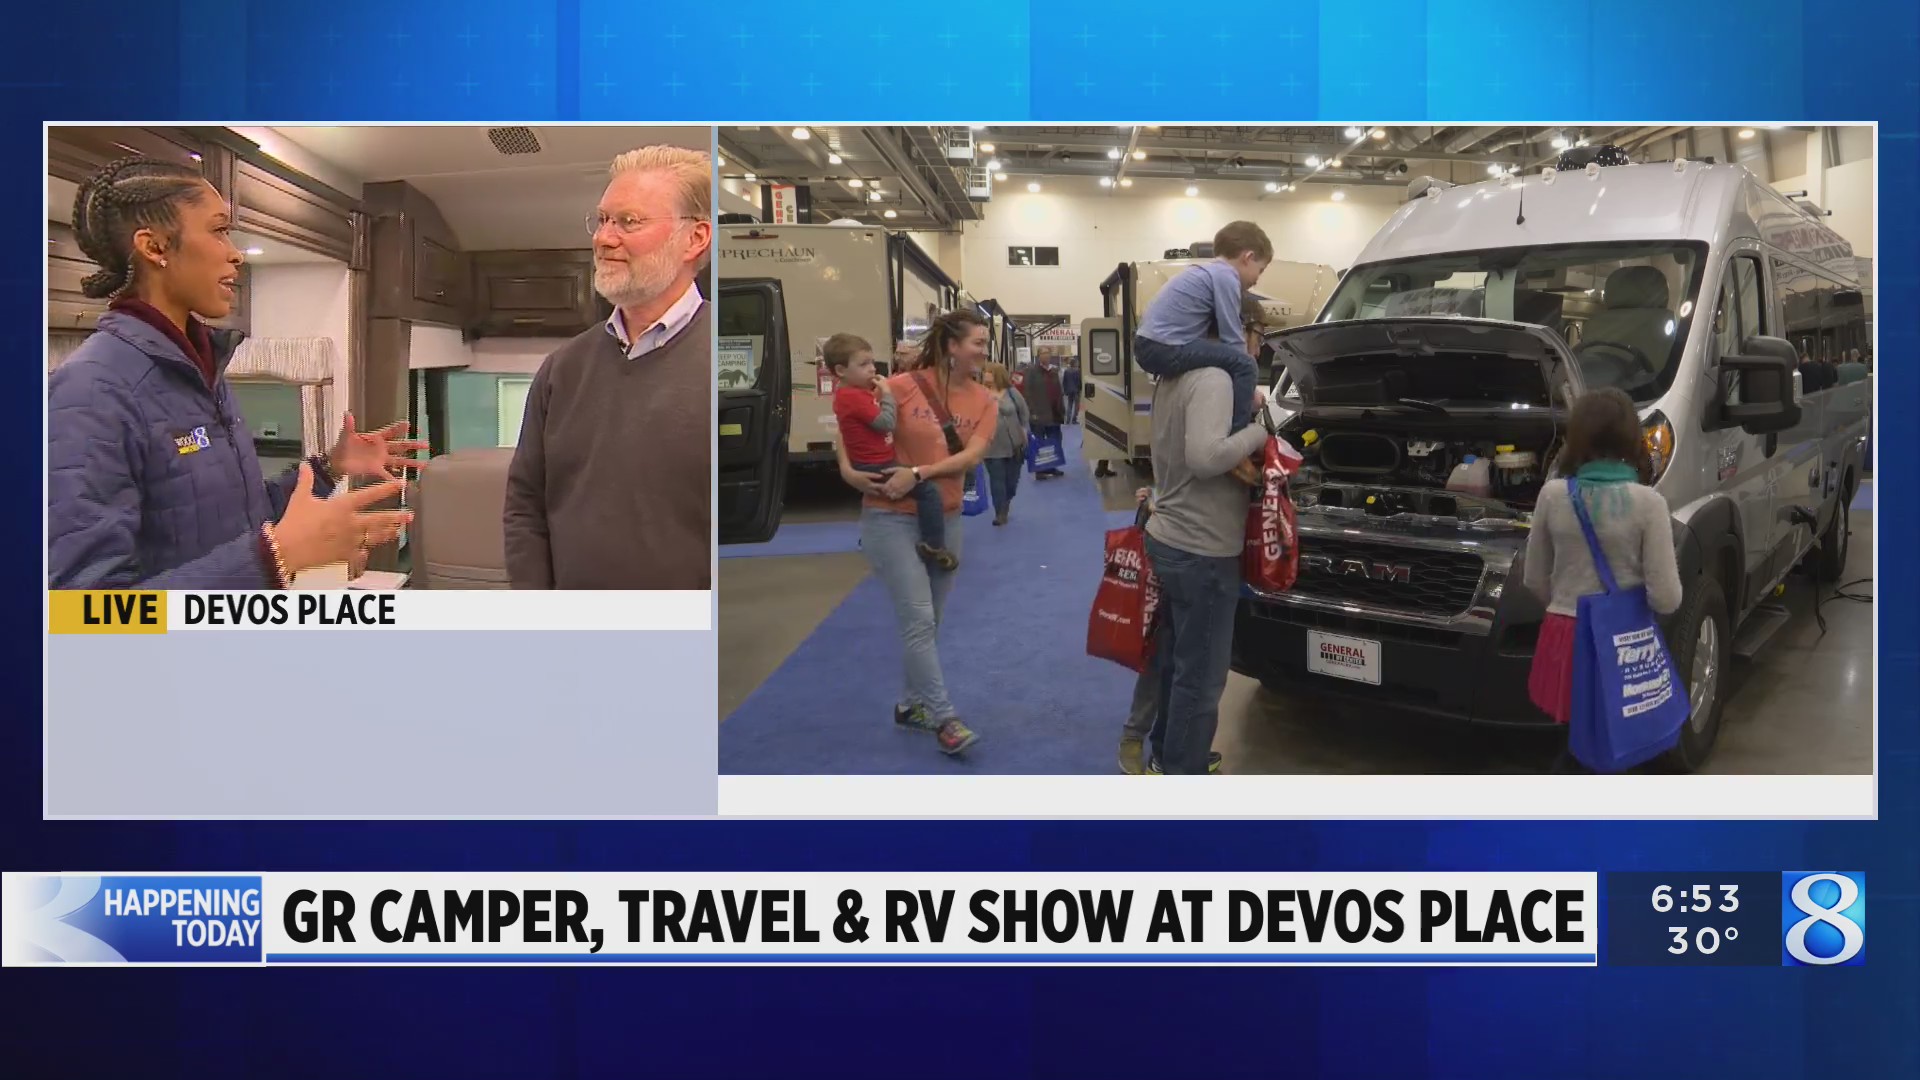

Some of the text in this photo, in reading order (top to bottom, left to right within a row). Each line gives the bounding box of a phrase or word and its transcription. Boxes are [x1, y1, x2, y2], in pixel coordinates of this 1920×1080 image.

[718, 248, 815, 260] PRECHAUN
[1301, 555, 1411, 584] RAM
[1320, 642, 1365, 659] GENERAL
